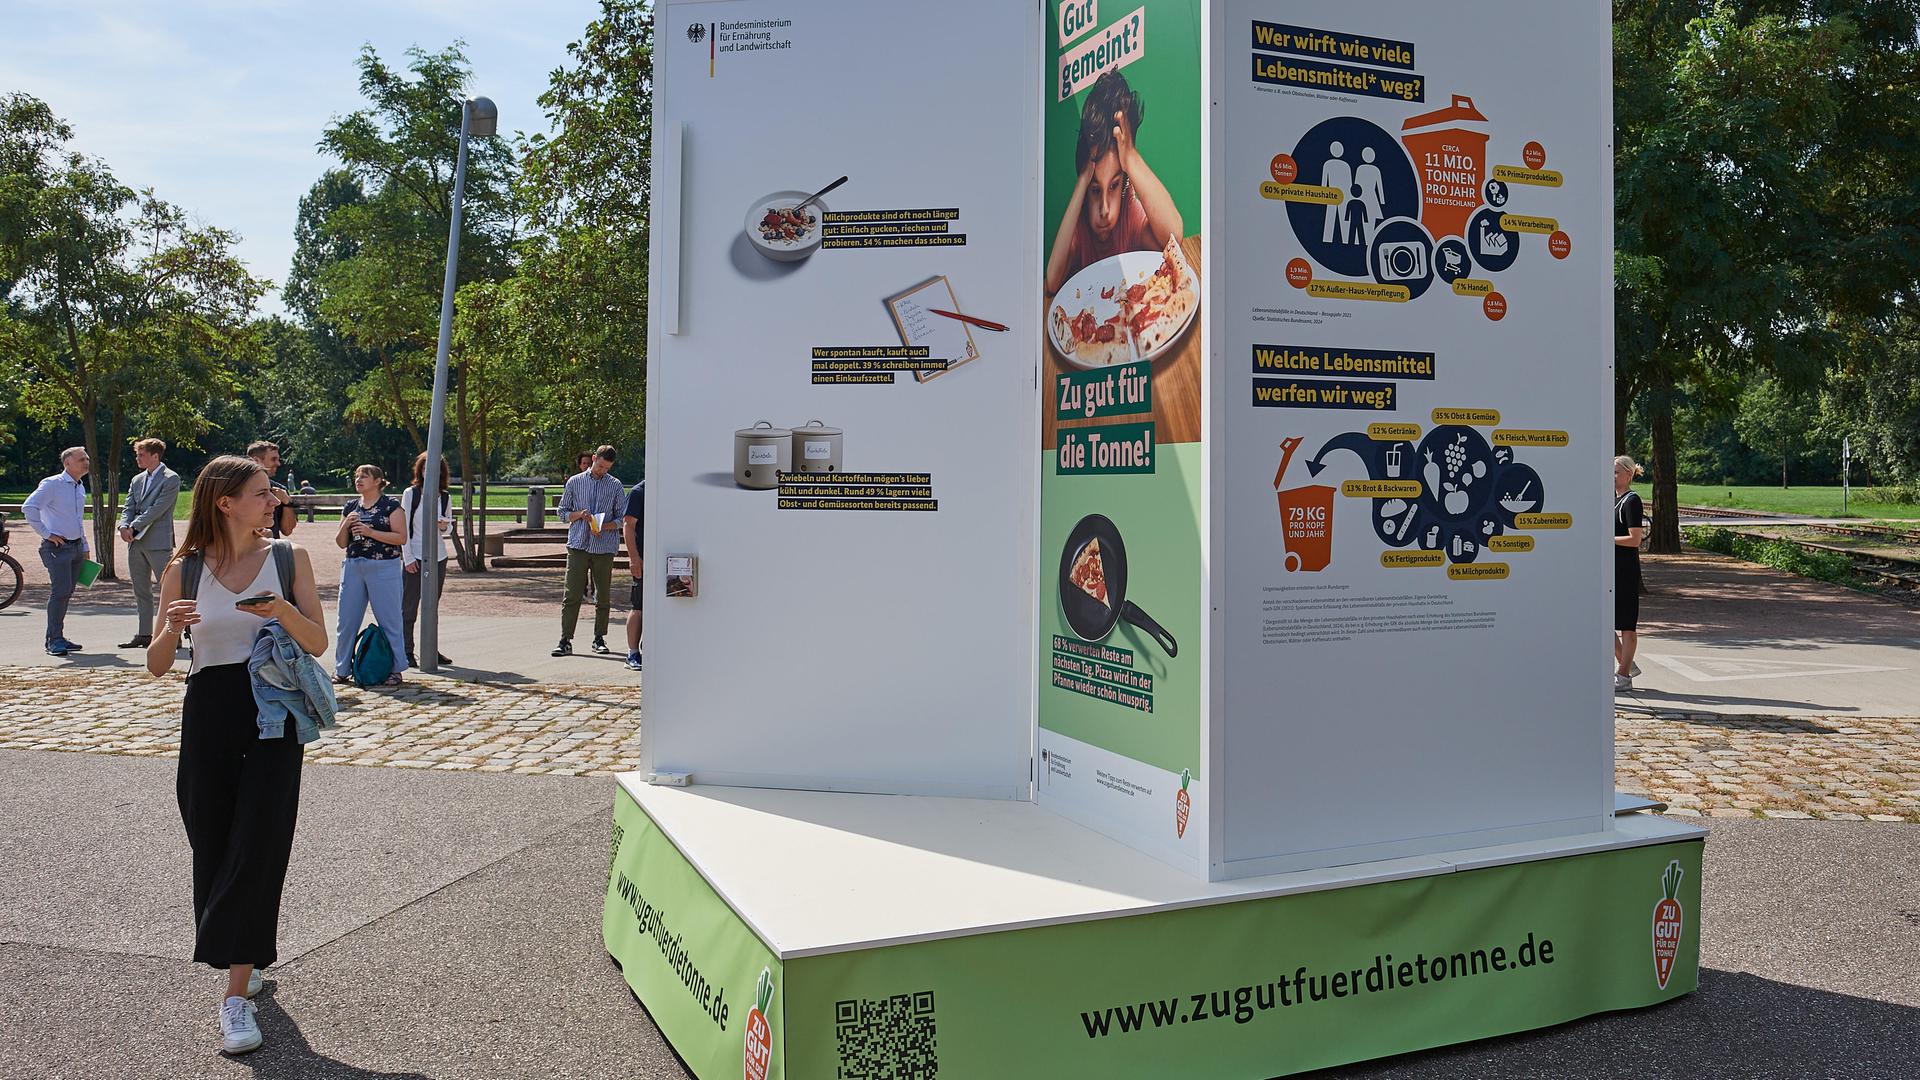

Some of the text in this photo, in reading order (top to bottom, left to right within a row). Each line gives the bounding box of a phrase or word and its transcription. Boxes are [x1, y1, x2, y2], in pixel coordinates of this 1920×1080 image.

[1064, 0, 1092, 36] Gut
[720, 19, 791, 30] Bundesministerium
[720, 31, 771, 41] für Ernährung
[720, 40, 792, 52] und Landwirtschaft
[1256, 25, 1411, 64] Wer wirft wie viele
[1062, 15, 1139, 98] gemeint?
[1380, 79, 1421, 100] weg?
[1425, 152, 1476, 171] 11 MIO.
[1425, 169, 1476, 185] TONNEN
[1508, 171, 1558, 182] Primärproduktion
[1281, 188, 1304, 197] private
[1305, 190, 1338, 200] Haushalte
[1426, 183, 1476, 198] PRO JAHR
[1434, 197, 1476, 208] DEUTSCHLAND
[824, 210, 958, 222] Milchprodukte sind oft noch länger
[824, 223, 947, 236] gut: Einfach gucken, riechen und
[1517, 219, 1554, 231] Verarbeitung
[824, 239, 861, 249] probieren.
[883, 237, 913, 245] machen
[914, 237, 928, 245] das
[929, 236, 952, 244] schon
[1326, 285, 1405, 298] Außer-Haus-Verpflegung
[1467, 284, 1489, 292] Handel
[814, 347, 928, 358] Wer spontan kauft, kauft auch
[814, 361, 828, 369] mal
[830, 361, 861, 371] doppelt.
[882, 360, 919, 369] schreiben
[920, 360, 946, 369] immer
[1256, 349, 1432, 375] Welche Lebensmittel
[835, 374, 893, 383] Einkaufszettel.
[1060, 367, 1148, 417] Zu gut für
[1256, 383, 1393, 409] werfen wir weg?
[1450, 412, 1466, 420] Obst
[1472, 413, 1496, 421] Gemüse
[1388, 427, 1417, 435] Getränke
[1506, 434, 1527, 442] Fleisch,
[1060, 430, 1150, 469] die Tonne!
[780, 474, 929, 484] Zwiebeln und Kartoffeln mögen's lieber
[780, 486, 797, 495] kühl
[798, 487, 813, 495] und
[814, 487, 842, 495] dunkel.
[844, 487, 865, 496] Rund
[886, 488, 910, 497] lagern
[911, 488, 930, 496] viele
[1362, 484, 1376, 492] Brot
[1383, 484, 1417, 492] Backwaren
[780, 499, 936, 511] Obst- und Gemüsesorten bereits passend.
[1288, 507, 1325, 521] 79 KG
[1289, 521, 1325, 529] PRO KOPF
[1533, 517, 1569, 525] Zubereitetes
[1289, 530, 1325, 538] UND JAHR
[1503, 540, 1530, 549] Sonstiges
[1395, 554, 1441, 564] Fertigprodukte
[1462, 567, 1505, 577] Milchprodukte
[1068, 642, 1100, 658] verwerten
[1101, 646, 1120, 662] Reste
[1120, 653, 1132, 665] am
[1054, 655, 1080, 671] nächsten
[1095, 664, 1113, 681] Pizza
[1113, 669, 1130, 684] wird
[1130, 671, 1138, 686] in
[1139, 674, 1152, 690] der
[1054, 672, 1152, 713] Pfanne wieder schön knusprig.
[1662, 905, 1676, 920] ZU
[1655, 921, 1680, 939] GUT
[1656, 939, 1676, 949] FÜR DIE
[1657, 949, 1674, 958] TONNE
[1081, 932, 1555, 1039] www.zugutfuerdietonne.de
[752, 1014, 766, 1041] ZU
[747, 1030, 769, 1066] GUT
